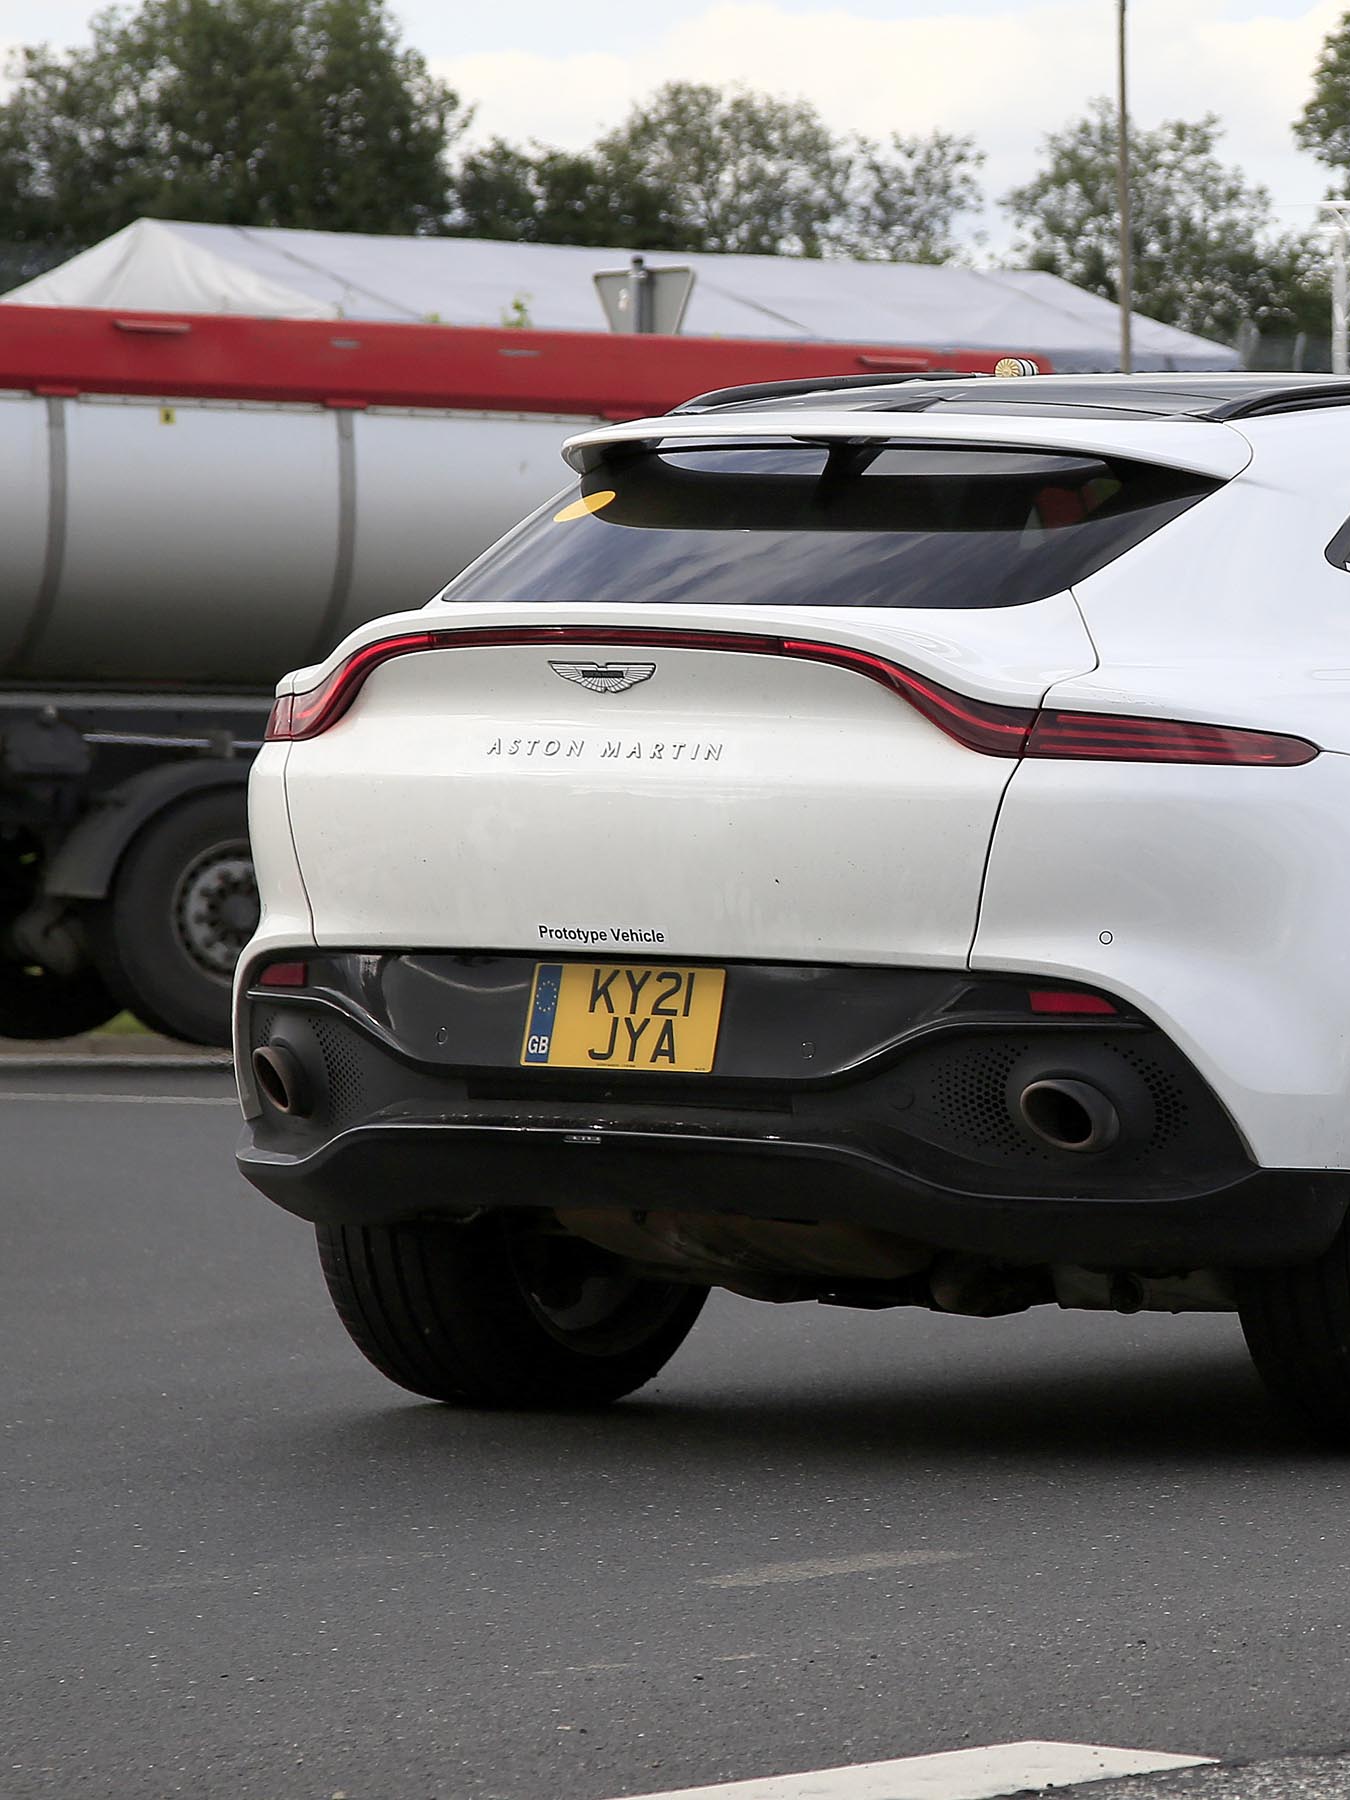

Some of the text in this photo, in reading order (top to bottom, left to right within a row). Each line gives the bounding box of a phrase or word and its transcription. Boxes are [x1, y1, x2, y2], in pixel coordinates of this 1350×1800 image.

[487, 737, 723, 762] ASTON MARTIN
[538, 925, 665, 944] Prototype Vehicle
[588, 968, 696, 1017] KY21
[527, 1035, 549, 1054] GB
[587, 1017, 676, 1064] JYA
